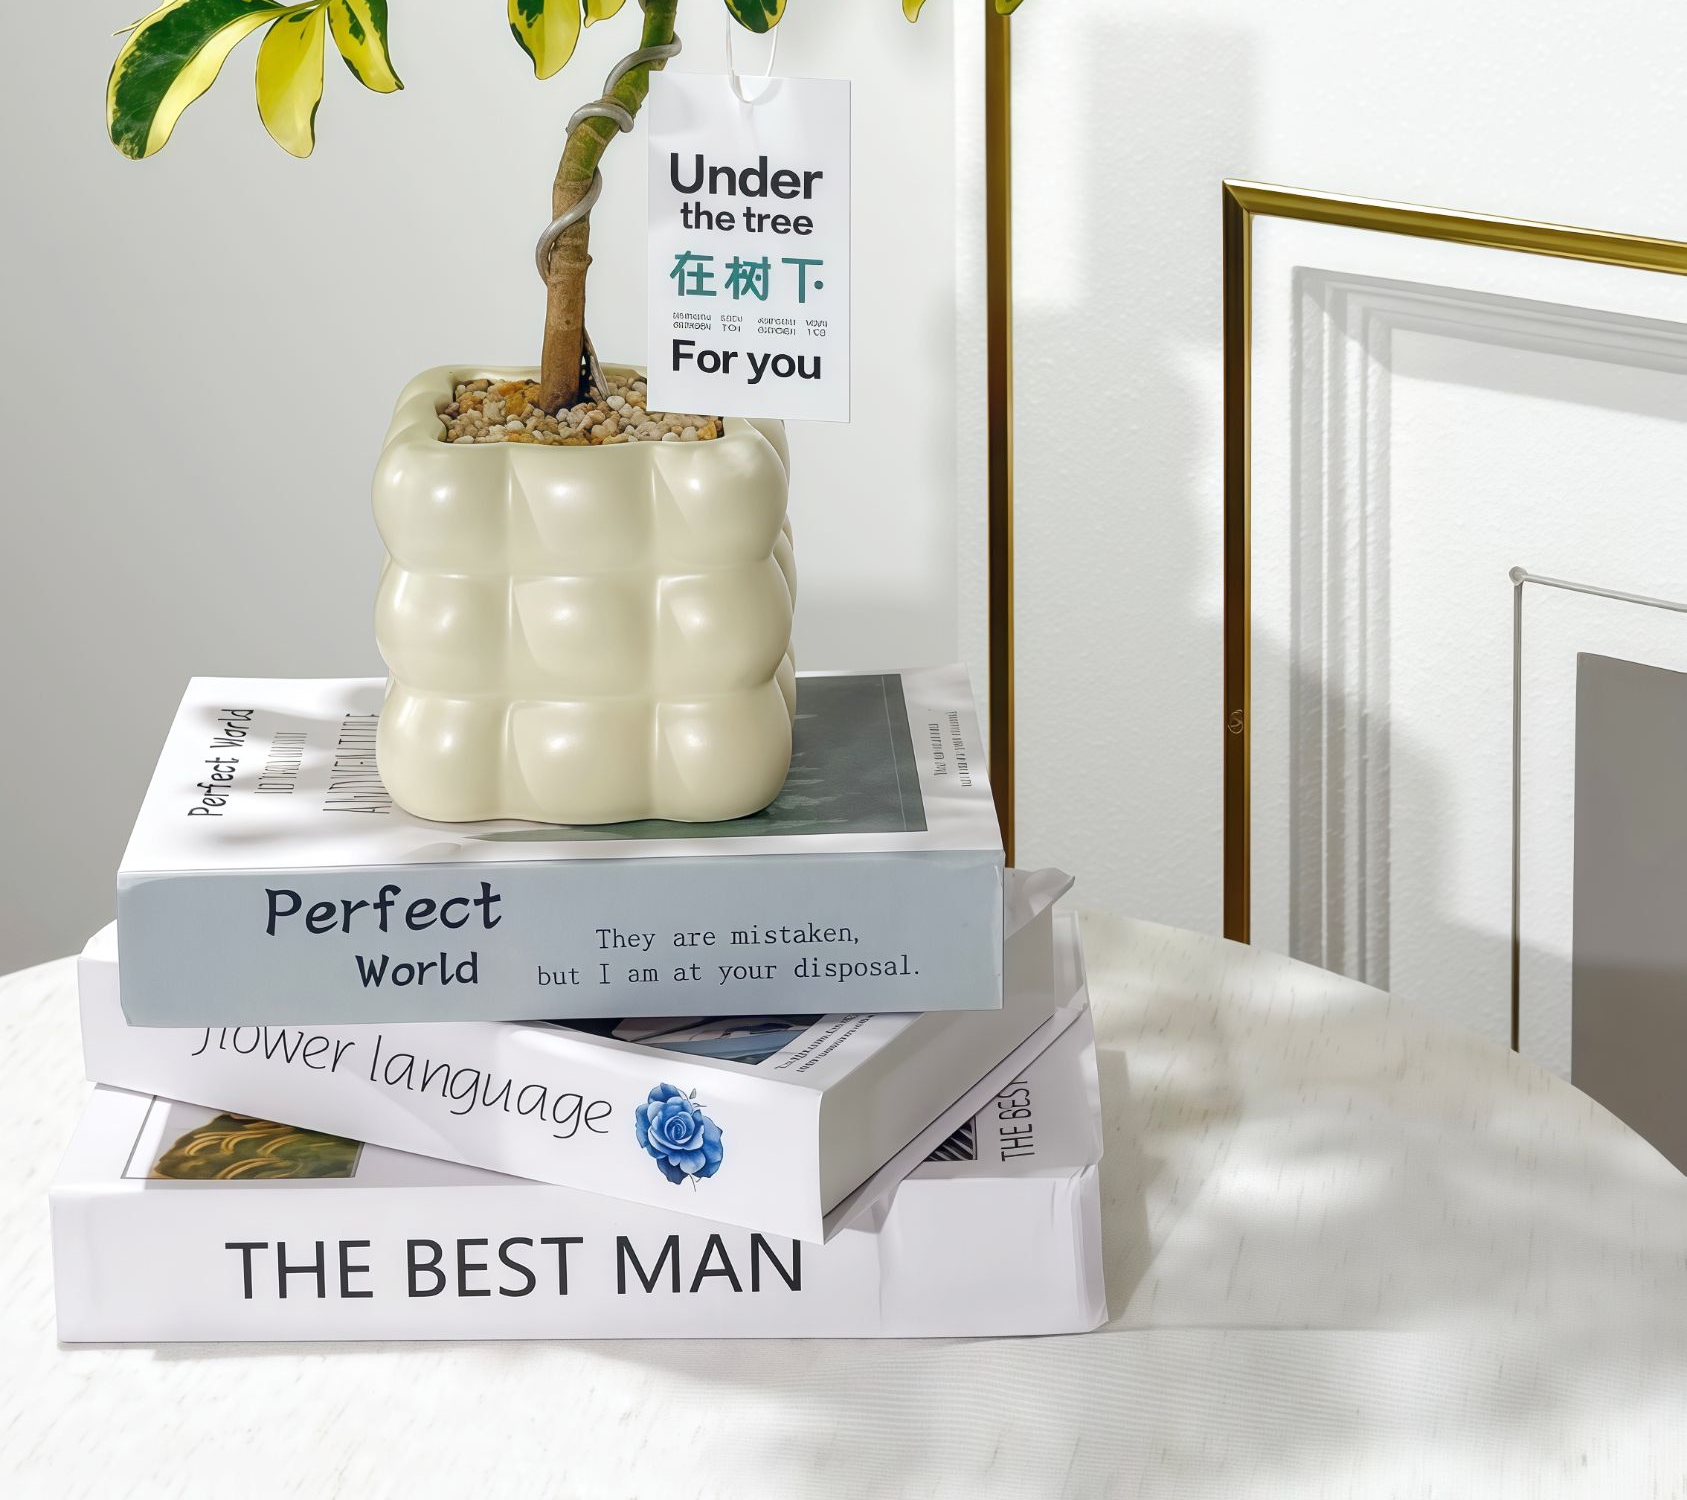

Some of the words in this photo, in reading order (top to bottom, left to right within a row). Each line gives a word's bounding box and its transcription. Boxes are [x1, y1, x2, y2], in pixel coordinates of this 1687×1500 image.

[671, 153, 823, 199] Under
[680, 202, 735, 231] the
[743, 207, 813, 235] tree
[670, 251, 823, 303] 在树下
[673, 339, 738, 374] For
[747, 352, 821, 384] you
[209, 708, 255, 749] World
[187, 756, 240, 817] Perfect
[265, 882, 501, 936] Perfect
[596, 928, 656, 951] They
[674, 932, 715, 947] are
[730, 923, 858, 944] mistaken,
[355, 951, 478, 987] World
[538, 966, 579, 985] but
[600, 964, 610, 984] I
[629, 969, 659, 982] am
[674, 964, 701, 981] at
[718, 966, 776, 985] your
[794, 955, 918, 982] disposal.
[370, 1035, 612, 1139] language
[1000, 1123, 1036, 1162] THE
[225, 1240, 373, 1299] THE
[407, 1237, 583, 1297] BEST
[617, 1233, 801, 1294] MAN
